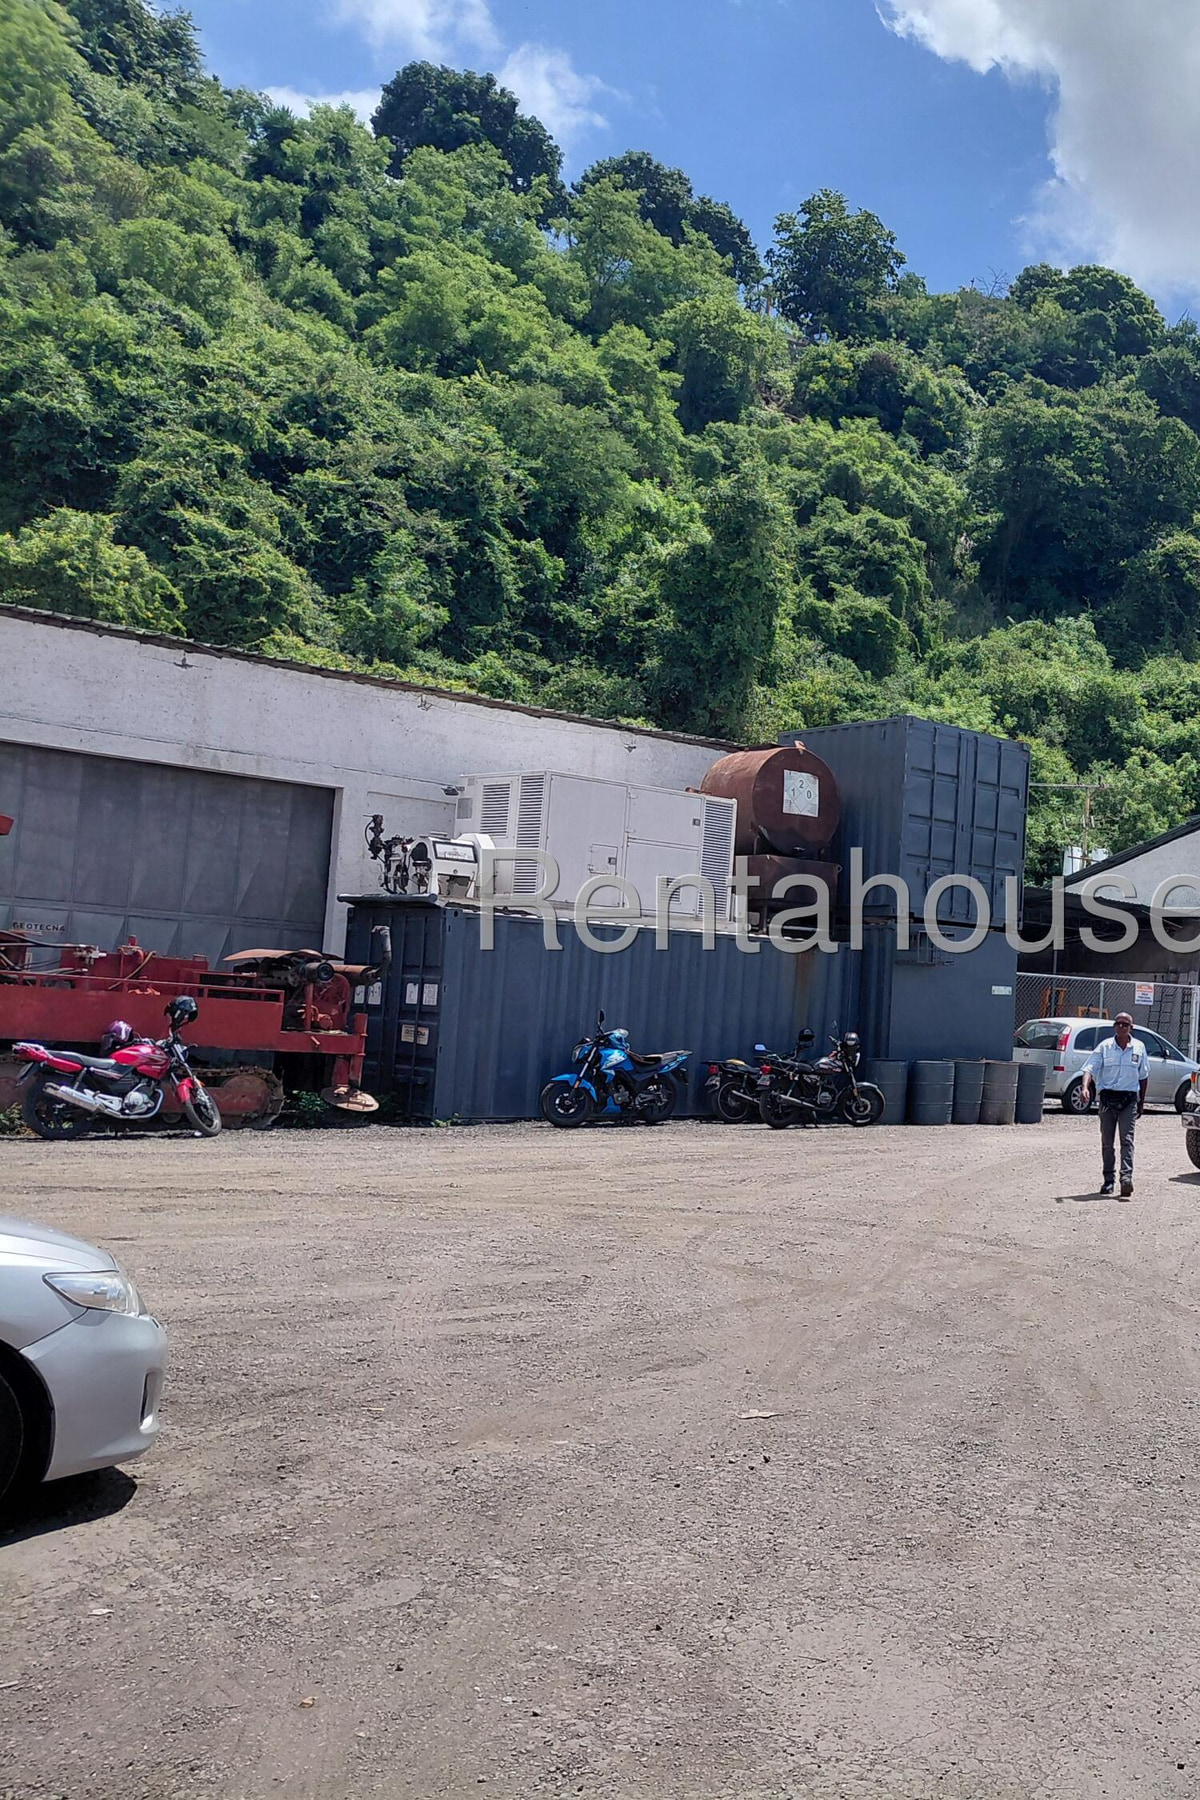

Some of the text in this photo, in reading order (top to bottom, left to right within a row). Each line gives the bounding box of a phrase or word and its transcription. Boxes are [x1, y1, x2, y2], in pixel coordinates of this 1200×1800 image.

[799, 780, 804, 788] 2
[807, 790, 811, 799] 0
[13, 922, 65, 931] GEOTECNA
